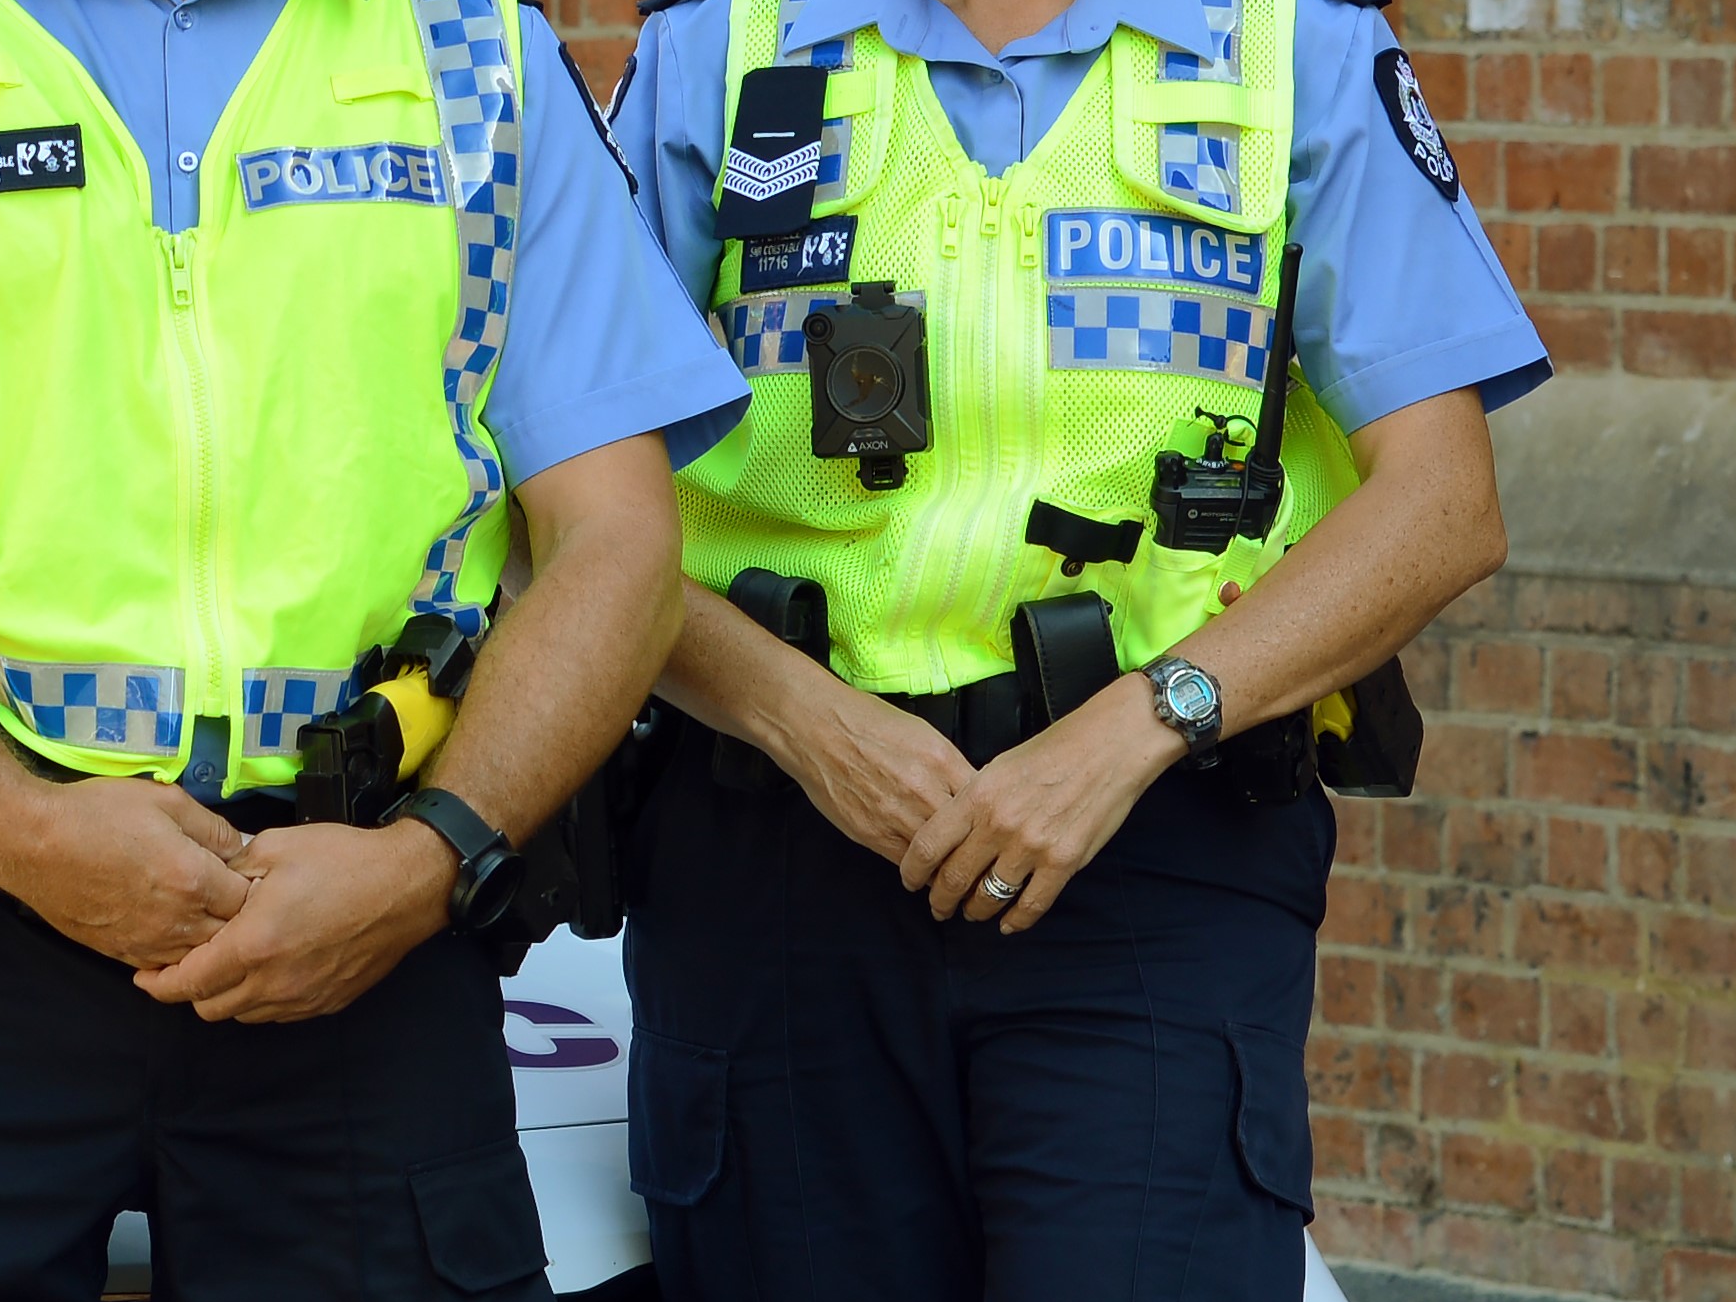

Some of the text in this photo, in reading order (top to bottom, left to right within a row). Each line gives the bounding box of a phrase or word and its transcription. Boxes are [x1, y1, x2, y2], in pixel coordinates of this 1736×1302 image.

[245, 151, 442, 202] POLICE
[758, 255, 789, 273] 11716
[1059, 218, 1262, 285] POLICE
[859, 440, 889, 451] AXON
